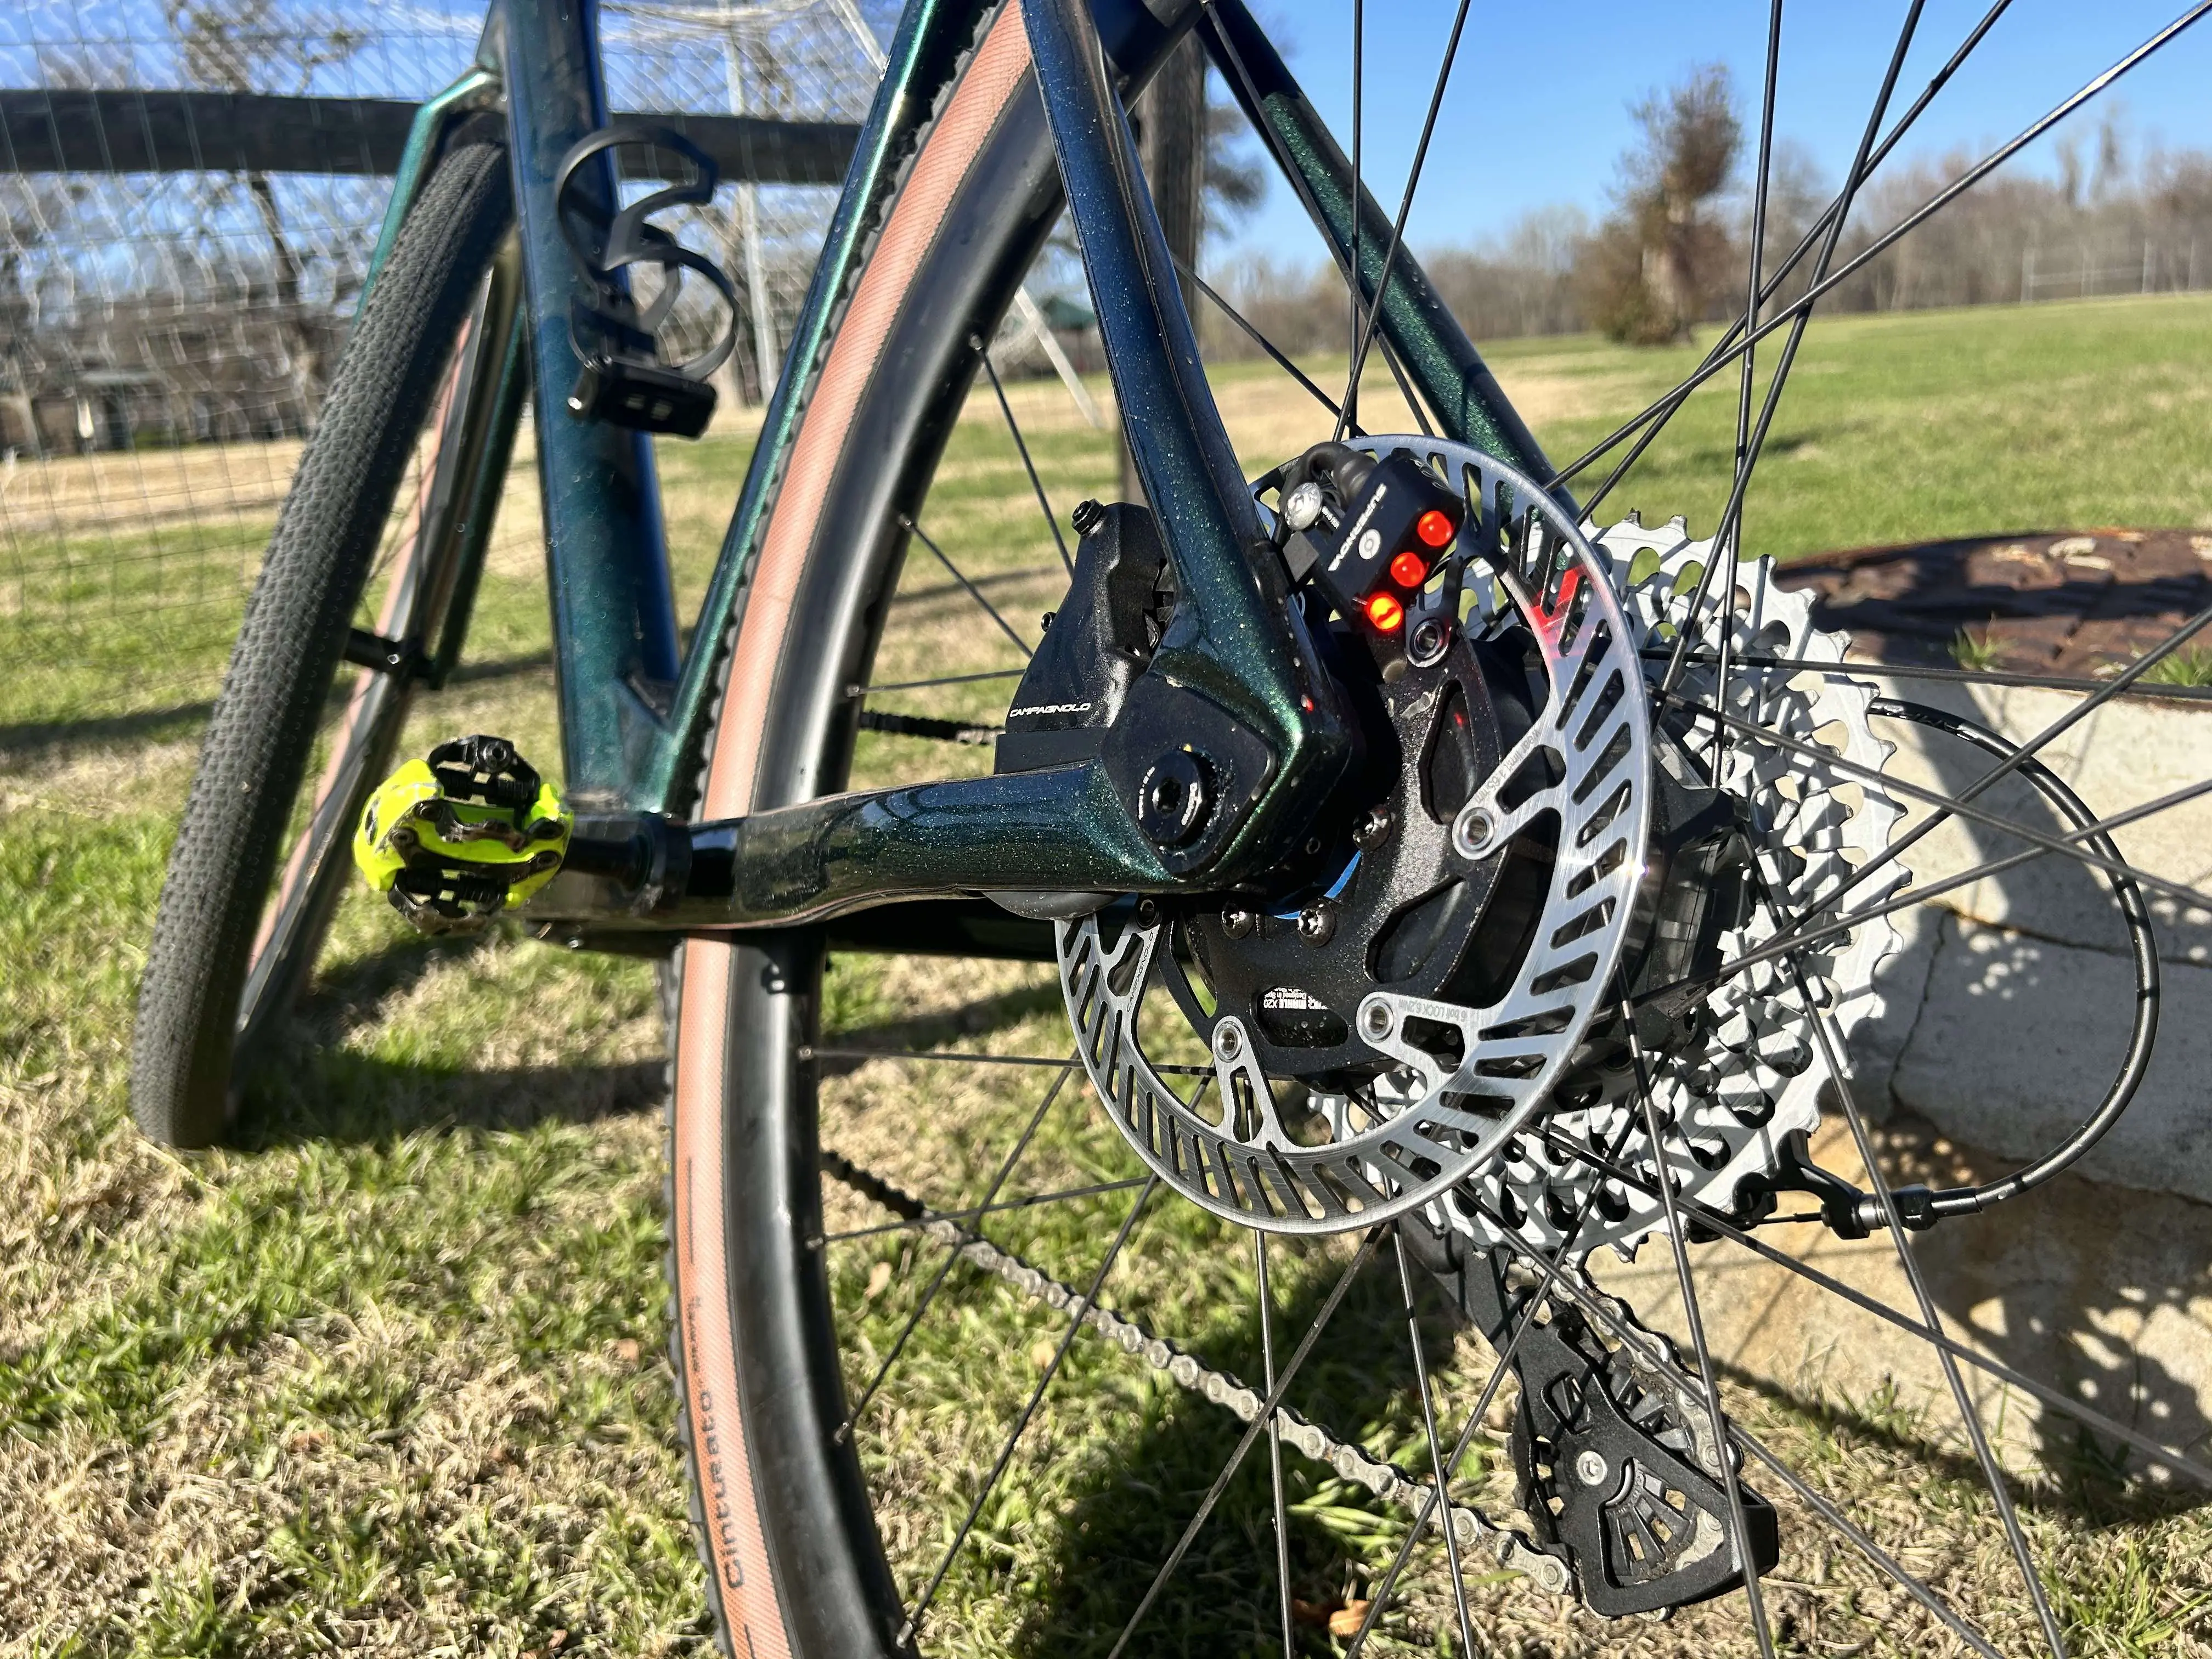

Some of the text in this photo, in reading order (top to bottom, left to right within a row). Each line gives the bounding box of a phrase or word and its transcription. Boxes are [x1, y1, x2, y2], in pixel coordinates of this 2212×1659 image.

[1328, 483, 1387, 571] SUPERNOVA
[1009, 703, 1091, 718] CAMPAGNOLO
[1126, 931, 1154, 1012] CAMPAGNOLO
[1263, 999, 1278, 1009] X20
[1423, 1002, 1445, 1018] LOCK
